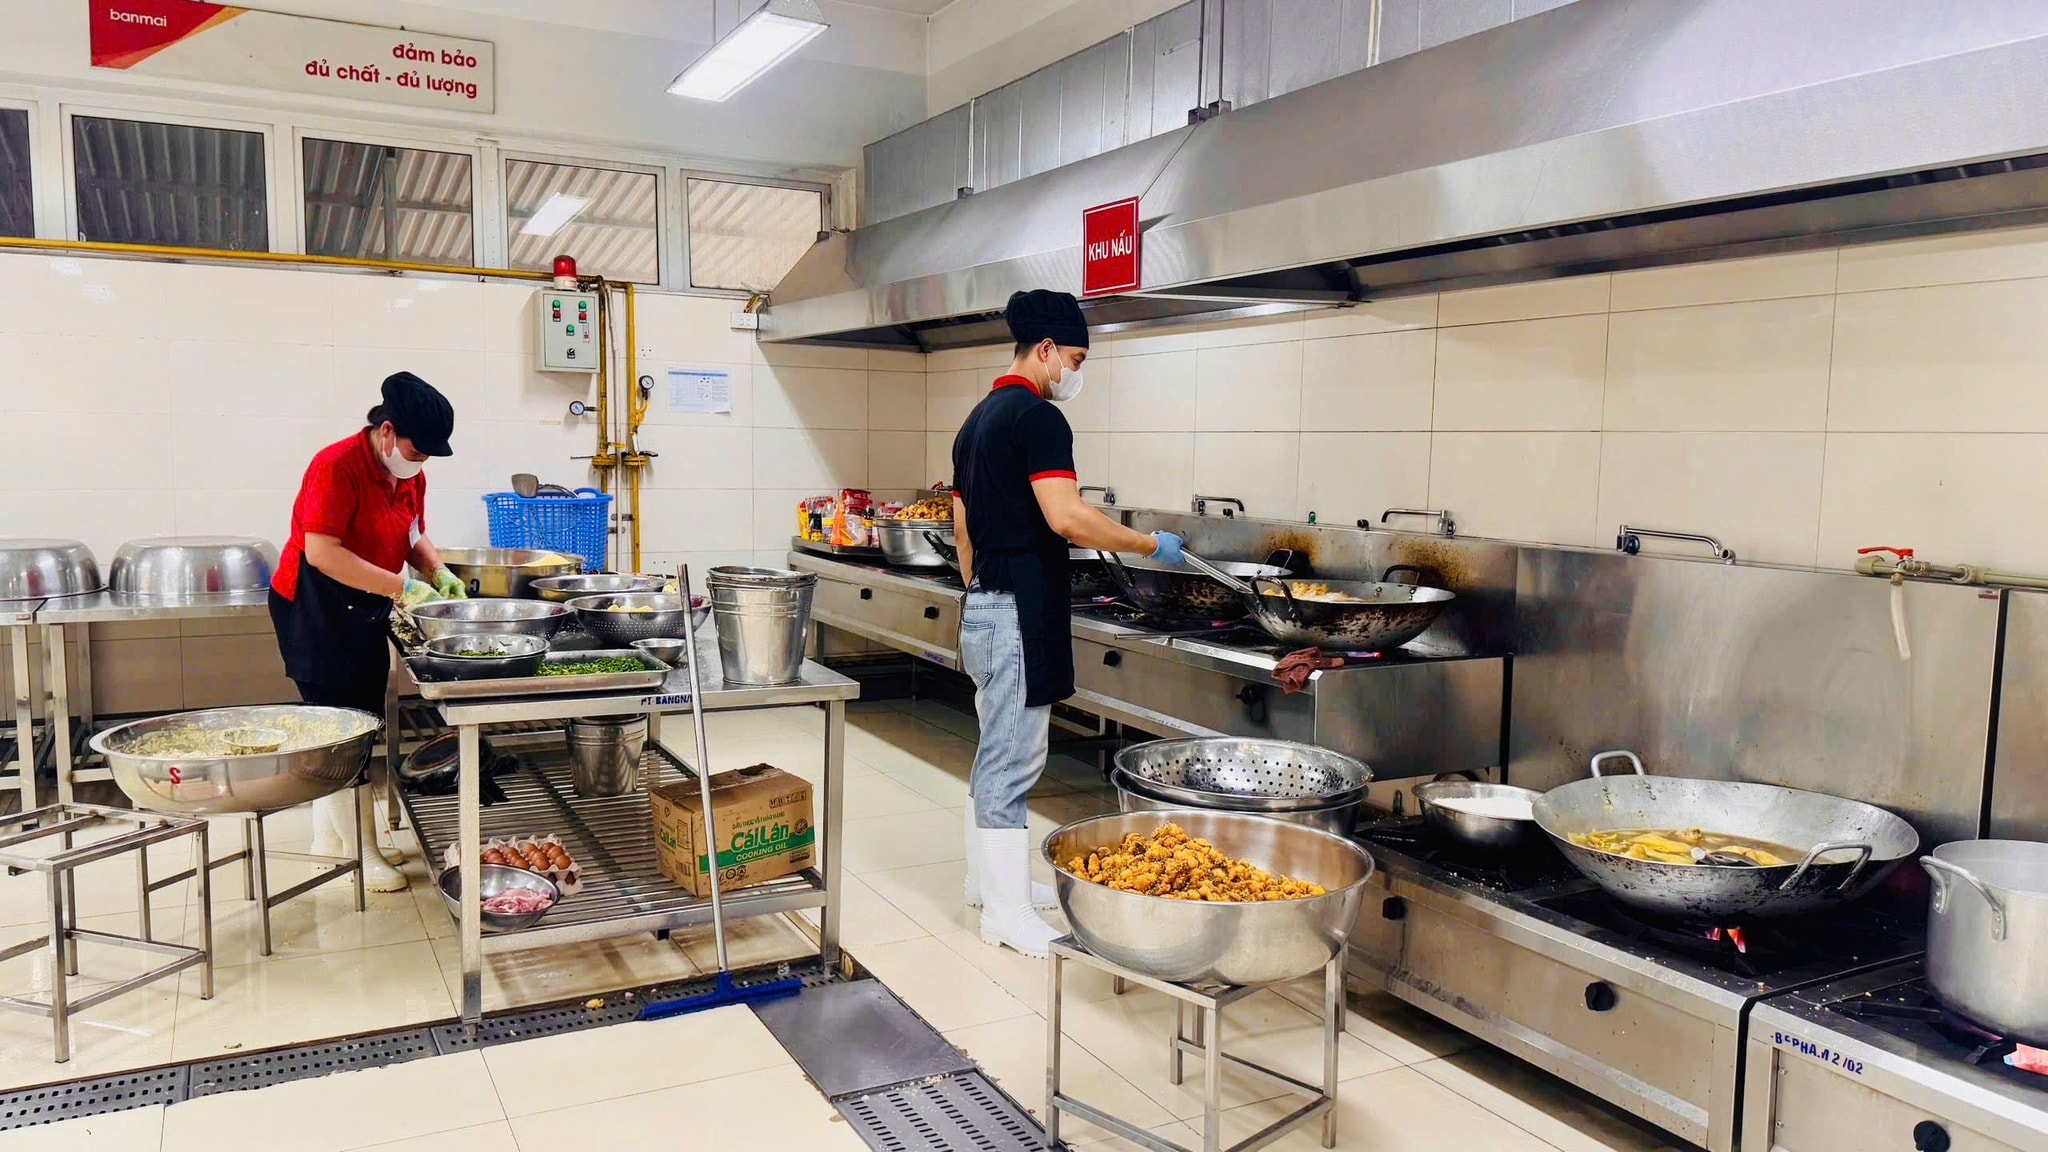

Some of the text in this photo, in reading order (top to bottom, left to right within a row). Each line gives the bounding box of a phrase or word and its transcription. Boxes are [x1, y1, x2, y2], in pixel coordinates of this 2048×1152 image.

[109, 9, 167, 27] banmai
[392, 43, 477, 68] đảm bảo
[305, 59, 330, 78] đủ
[336, 64, 381, 83] chất
[396, 70, 420, 89] đủ
[427, 75, 477, 99] lượng
[1088, 229, 1133, 262] KHU NẤU
[169, 767, 182, 785] S
[736, 843, 788, 861] COOKING OIL
